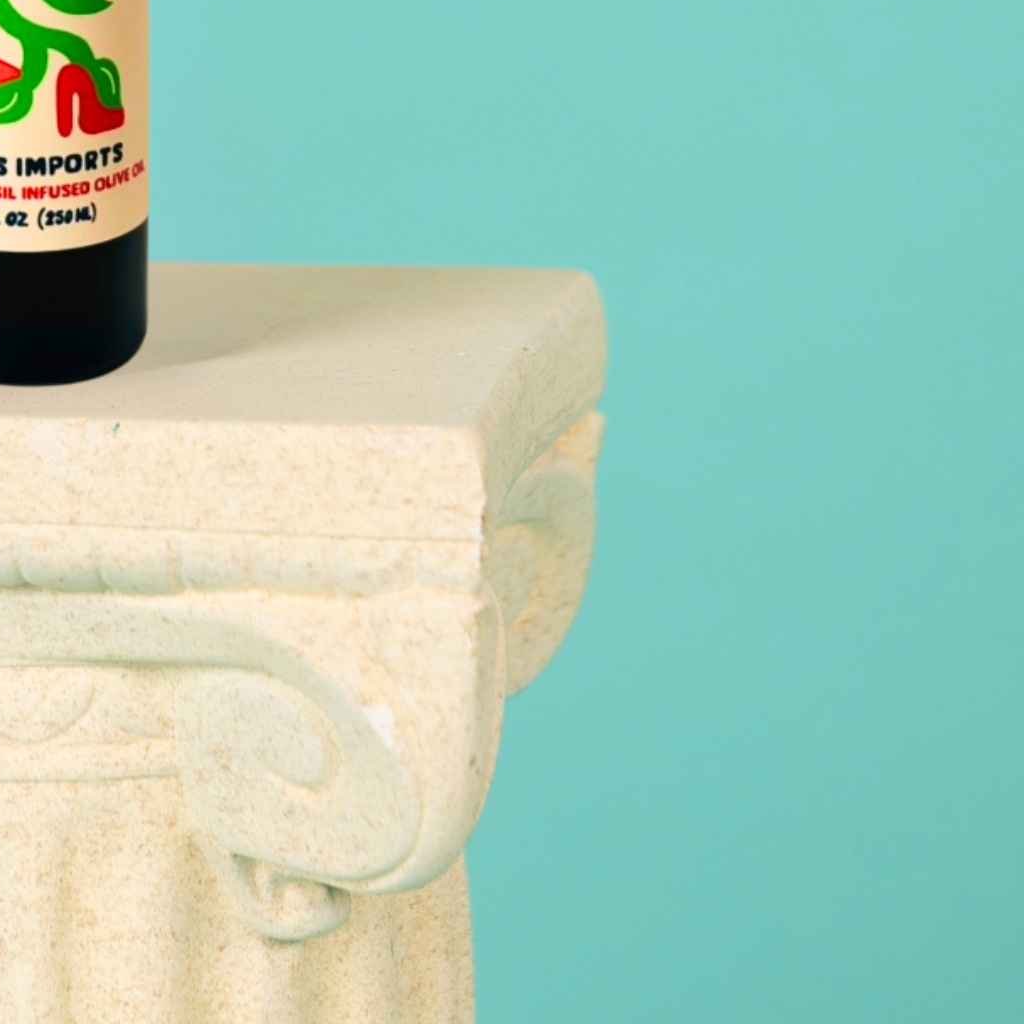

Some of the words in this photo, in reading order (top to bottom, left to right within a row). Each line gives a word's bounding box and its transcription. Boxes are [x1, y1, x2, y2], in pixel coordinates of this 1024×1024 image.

[16, 142, 124, 176] IMPORTS
[22, 181, 90, 200] INFUSED
[94, 168, 130, 192] OLIVE
[5, 211, 29, 227] OZ
[37, 207, 73, 230] (250
